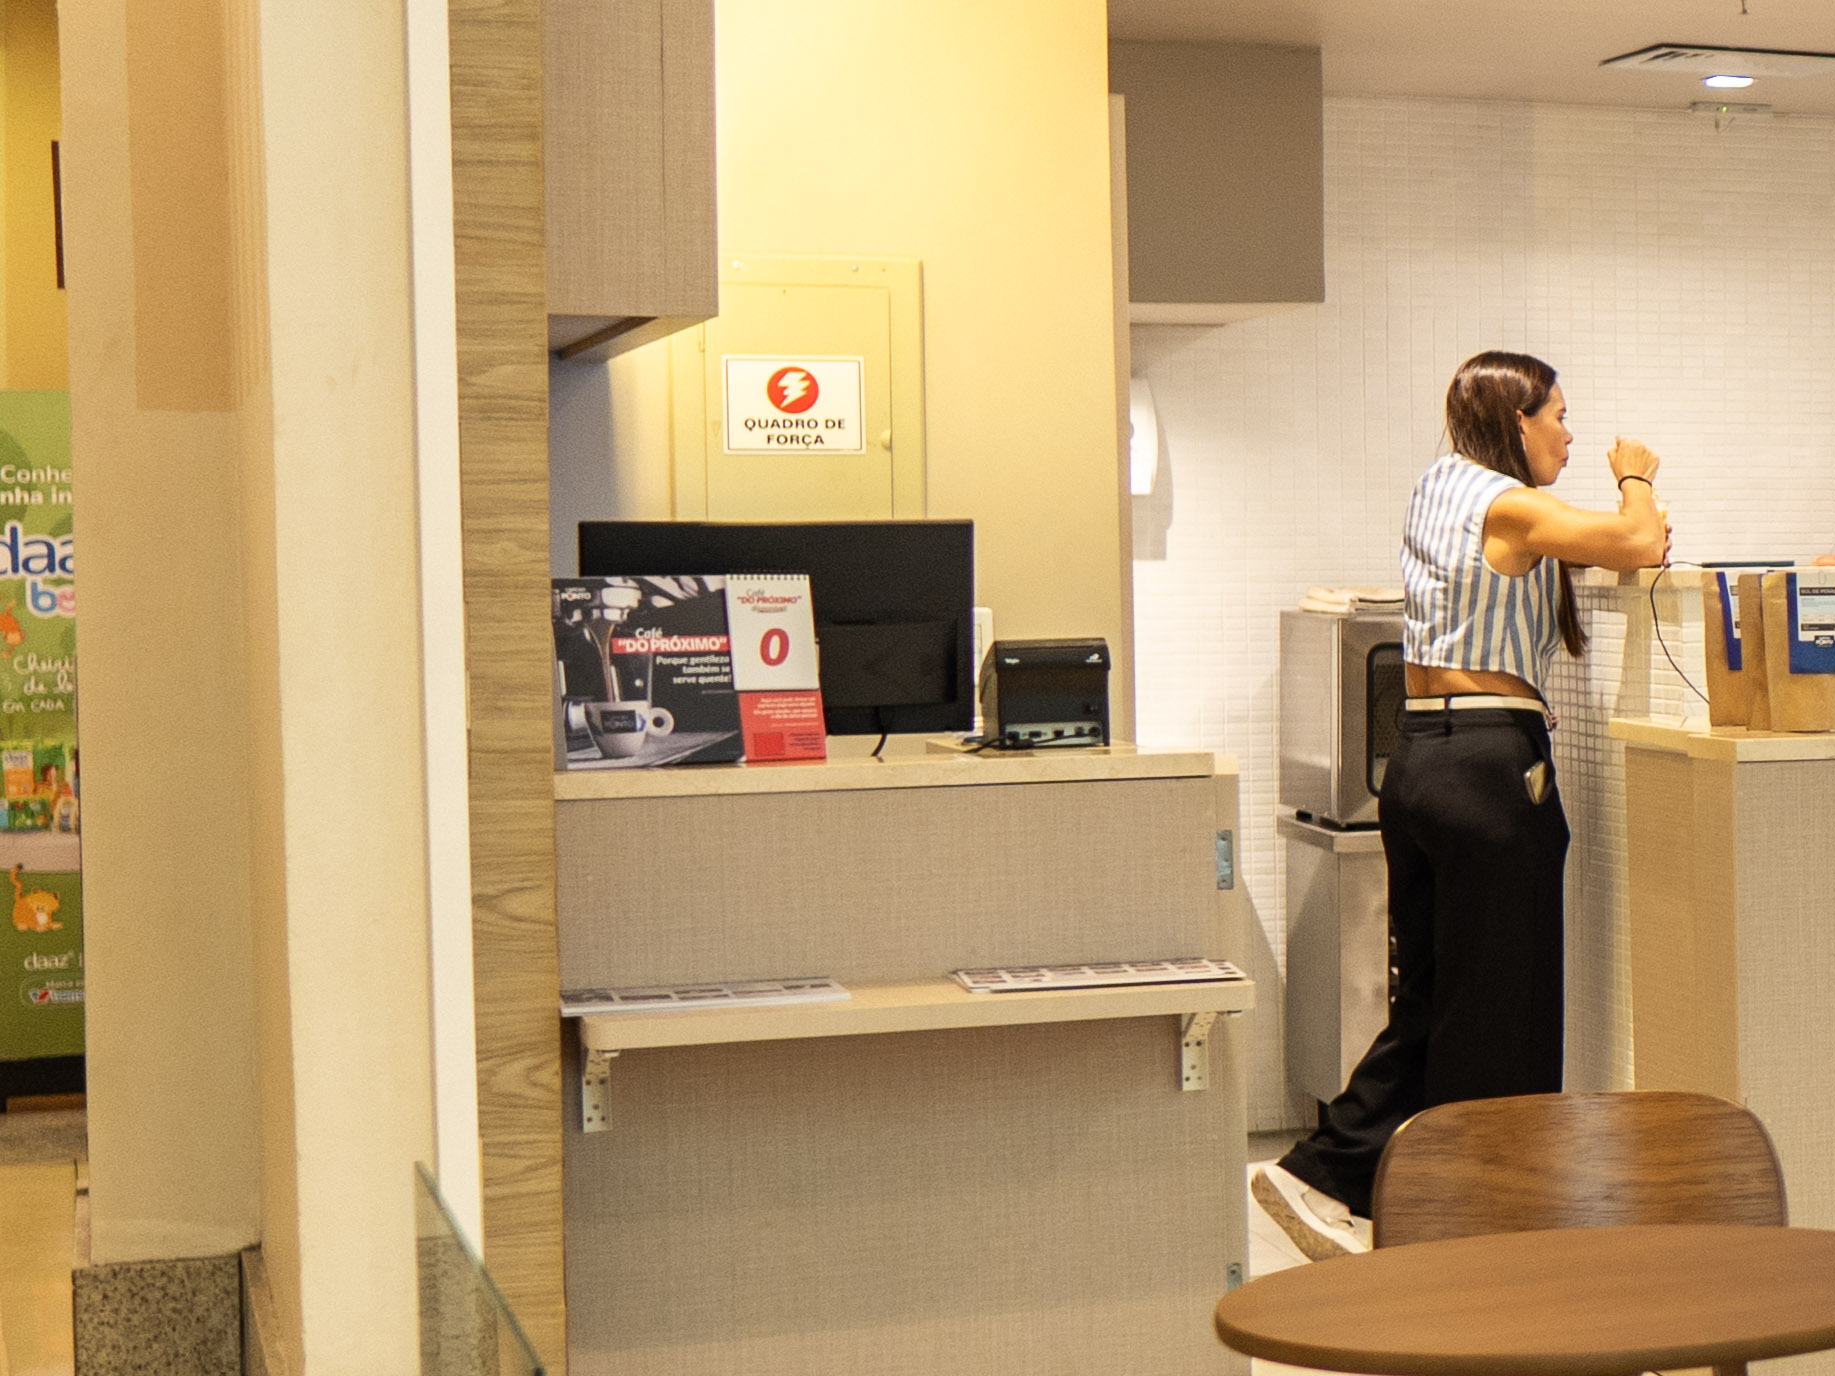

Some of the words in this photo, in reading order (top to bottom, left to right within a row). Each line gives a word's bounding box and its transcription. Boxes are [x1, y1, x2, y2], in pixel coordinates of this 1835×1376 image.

[744, 418, 818, 431] QUADRO
[825, 419, 845, 429] DE
[767, 434, 824, 449] FORÇA
[635, 627, 663, 639] Café
[760, 628, 789, 666] 0
